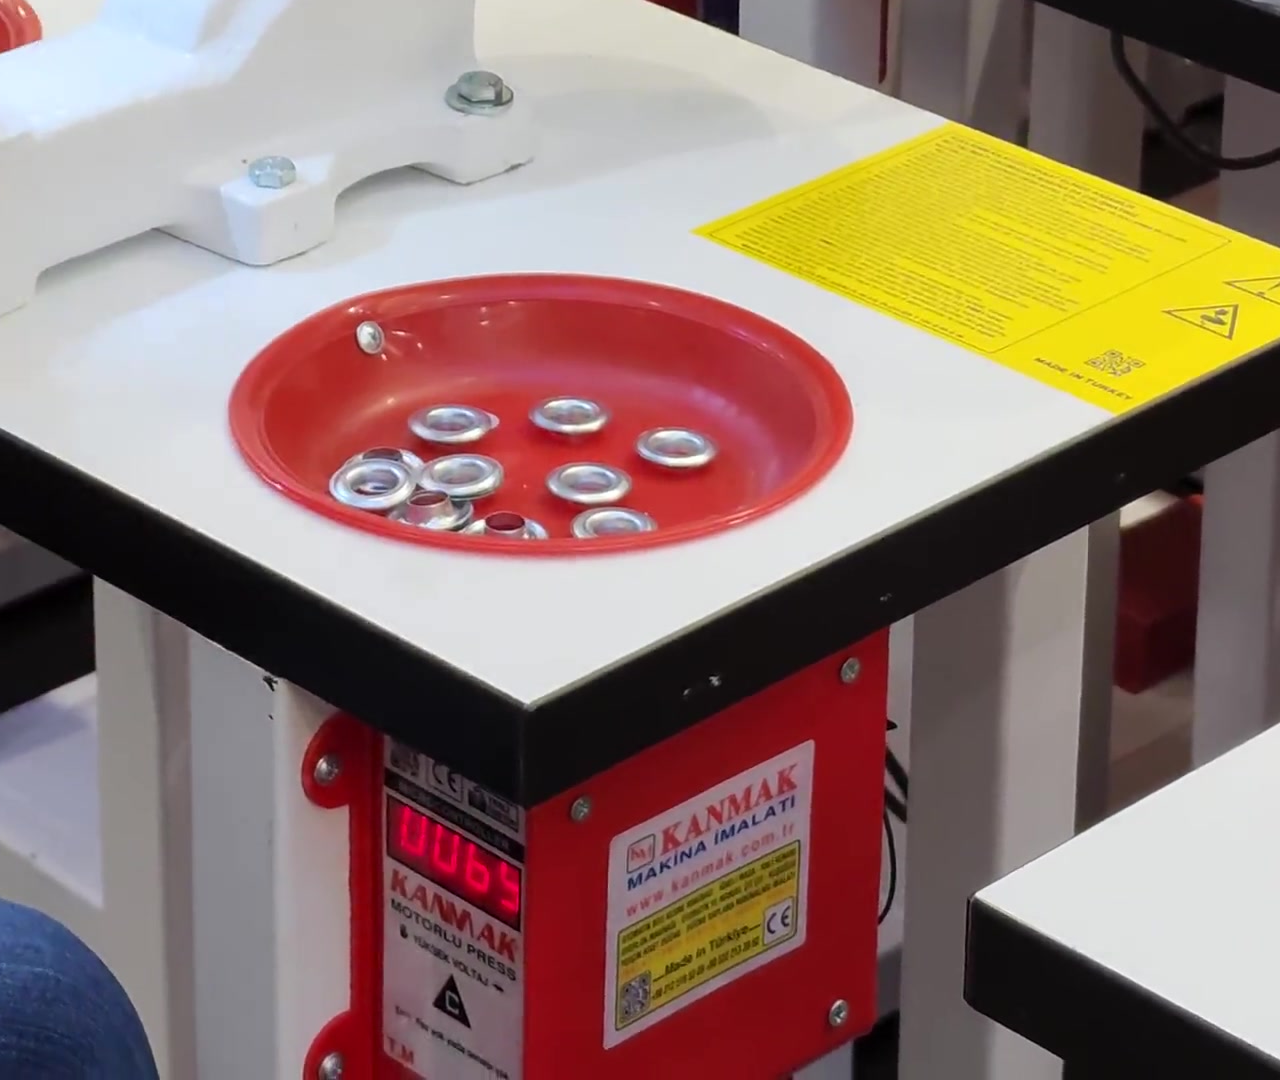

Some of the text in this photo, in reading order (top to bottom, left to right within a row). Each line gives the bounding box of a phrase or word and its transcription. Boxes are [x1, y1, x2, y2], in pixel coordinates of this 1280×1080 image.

[1034, 357, 1068, 373] MADE
[1069, 371, 1084, 380] IN
[660, 763, 798, 857] KANMAK
[390, 868, 518, 963] KANMAK
[391, 898, 517, 982] MOTORLU PRESS
[766, 905, 791, 935] CE
